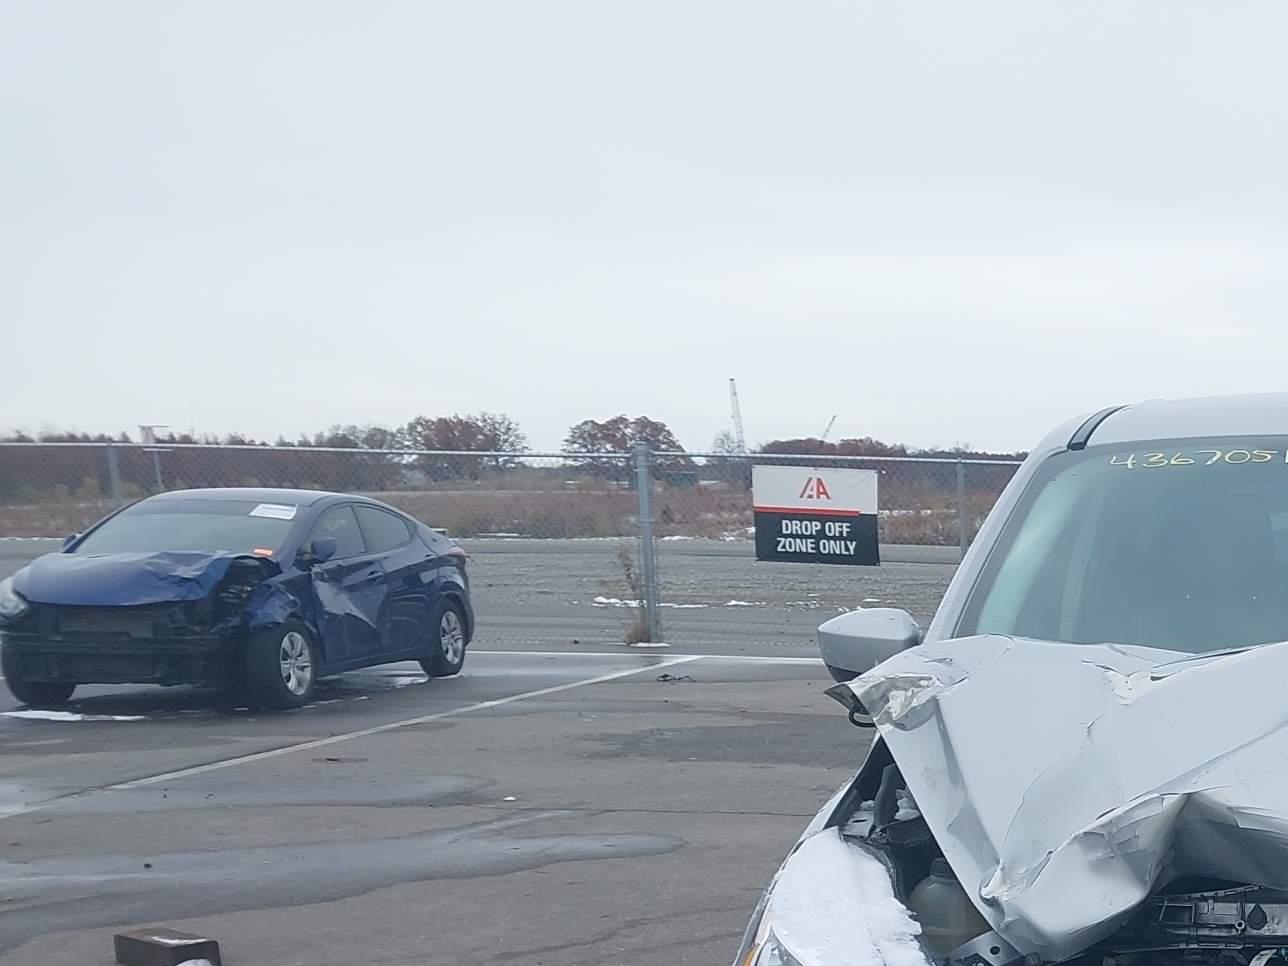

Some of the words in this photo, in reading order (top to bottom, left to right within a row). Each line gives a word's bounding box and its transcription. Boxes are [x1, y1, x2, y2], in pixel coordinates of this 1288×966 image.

[782, 520, 821, 536] DROP
[825, 522, 851, 537] OFF
[776, 538, 816, 554] ZONE
[819, 540, 856, 555] ONLY
